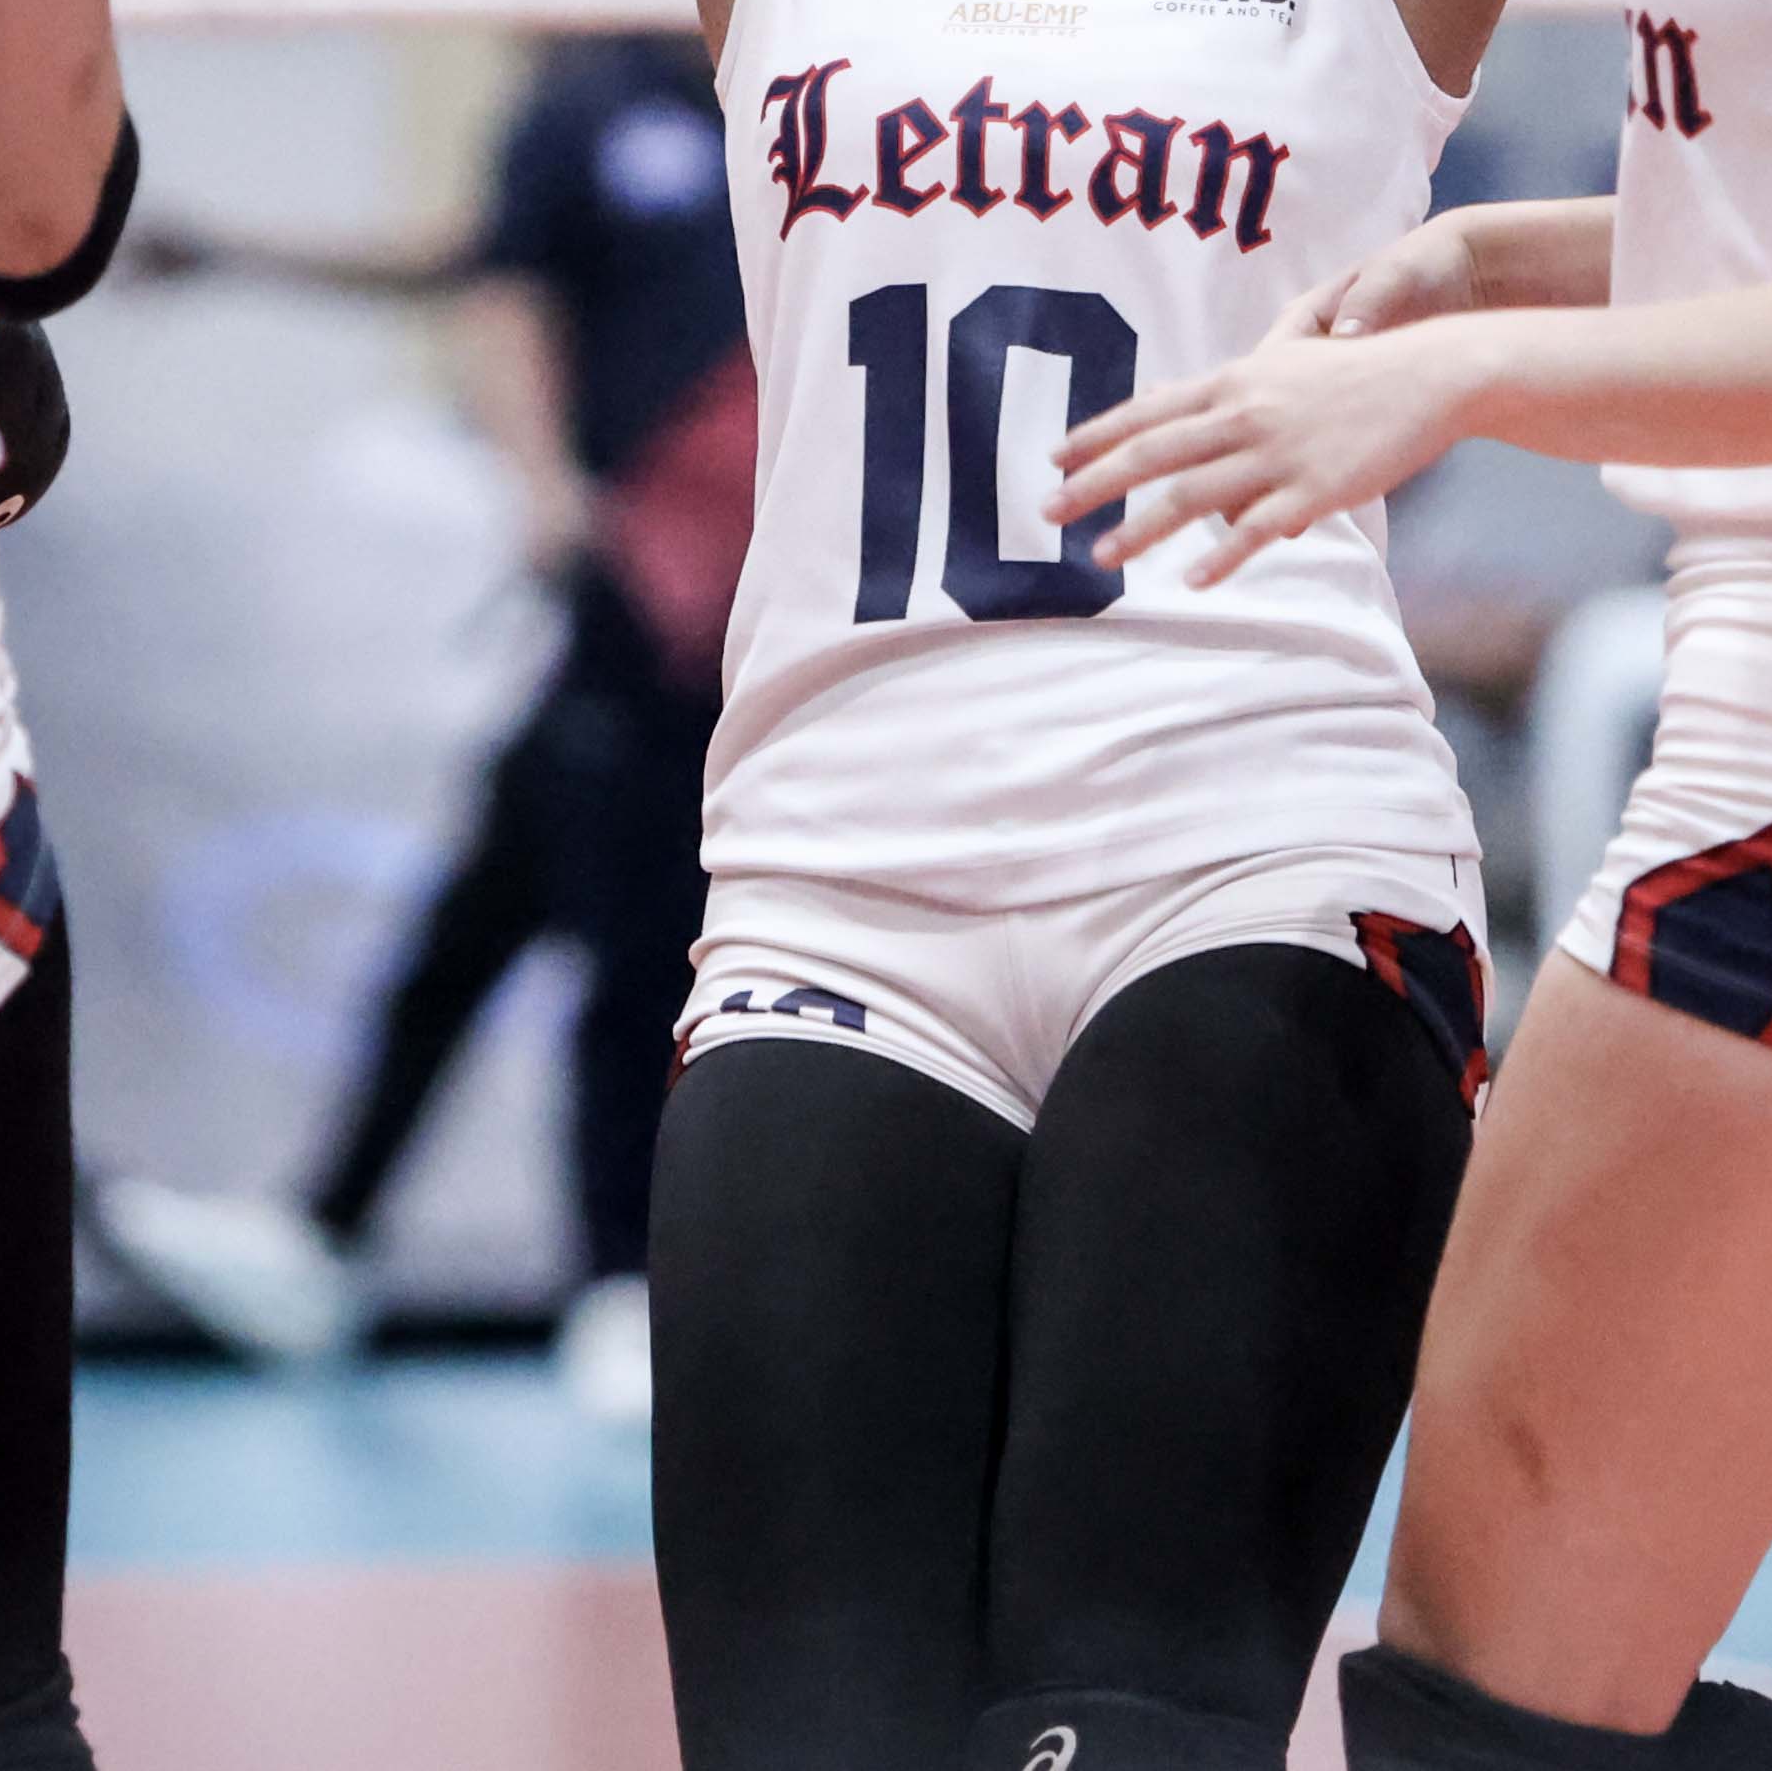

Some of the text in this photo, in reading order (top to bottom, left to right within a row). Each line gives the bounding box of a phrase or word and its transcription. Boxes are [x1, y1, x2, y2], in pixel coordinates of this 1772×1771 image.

[948, 2, 1088, 25] ABU-EMP
[1154, 1, 1293, 28] COFFEE AND TEA
[761, 57, 1290, 254] Letran
[848, 282, 1139, 626] 10
